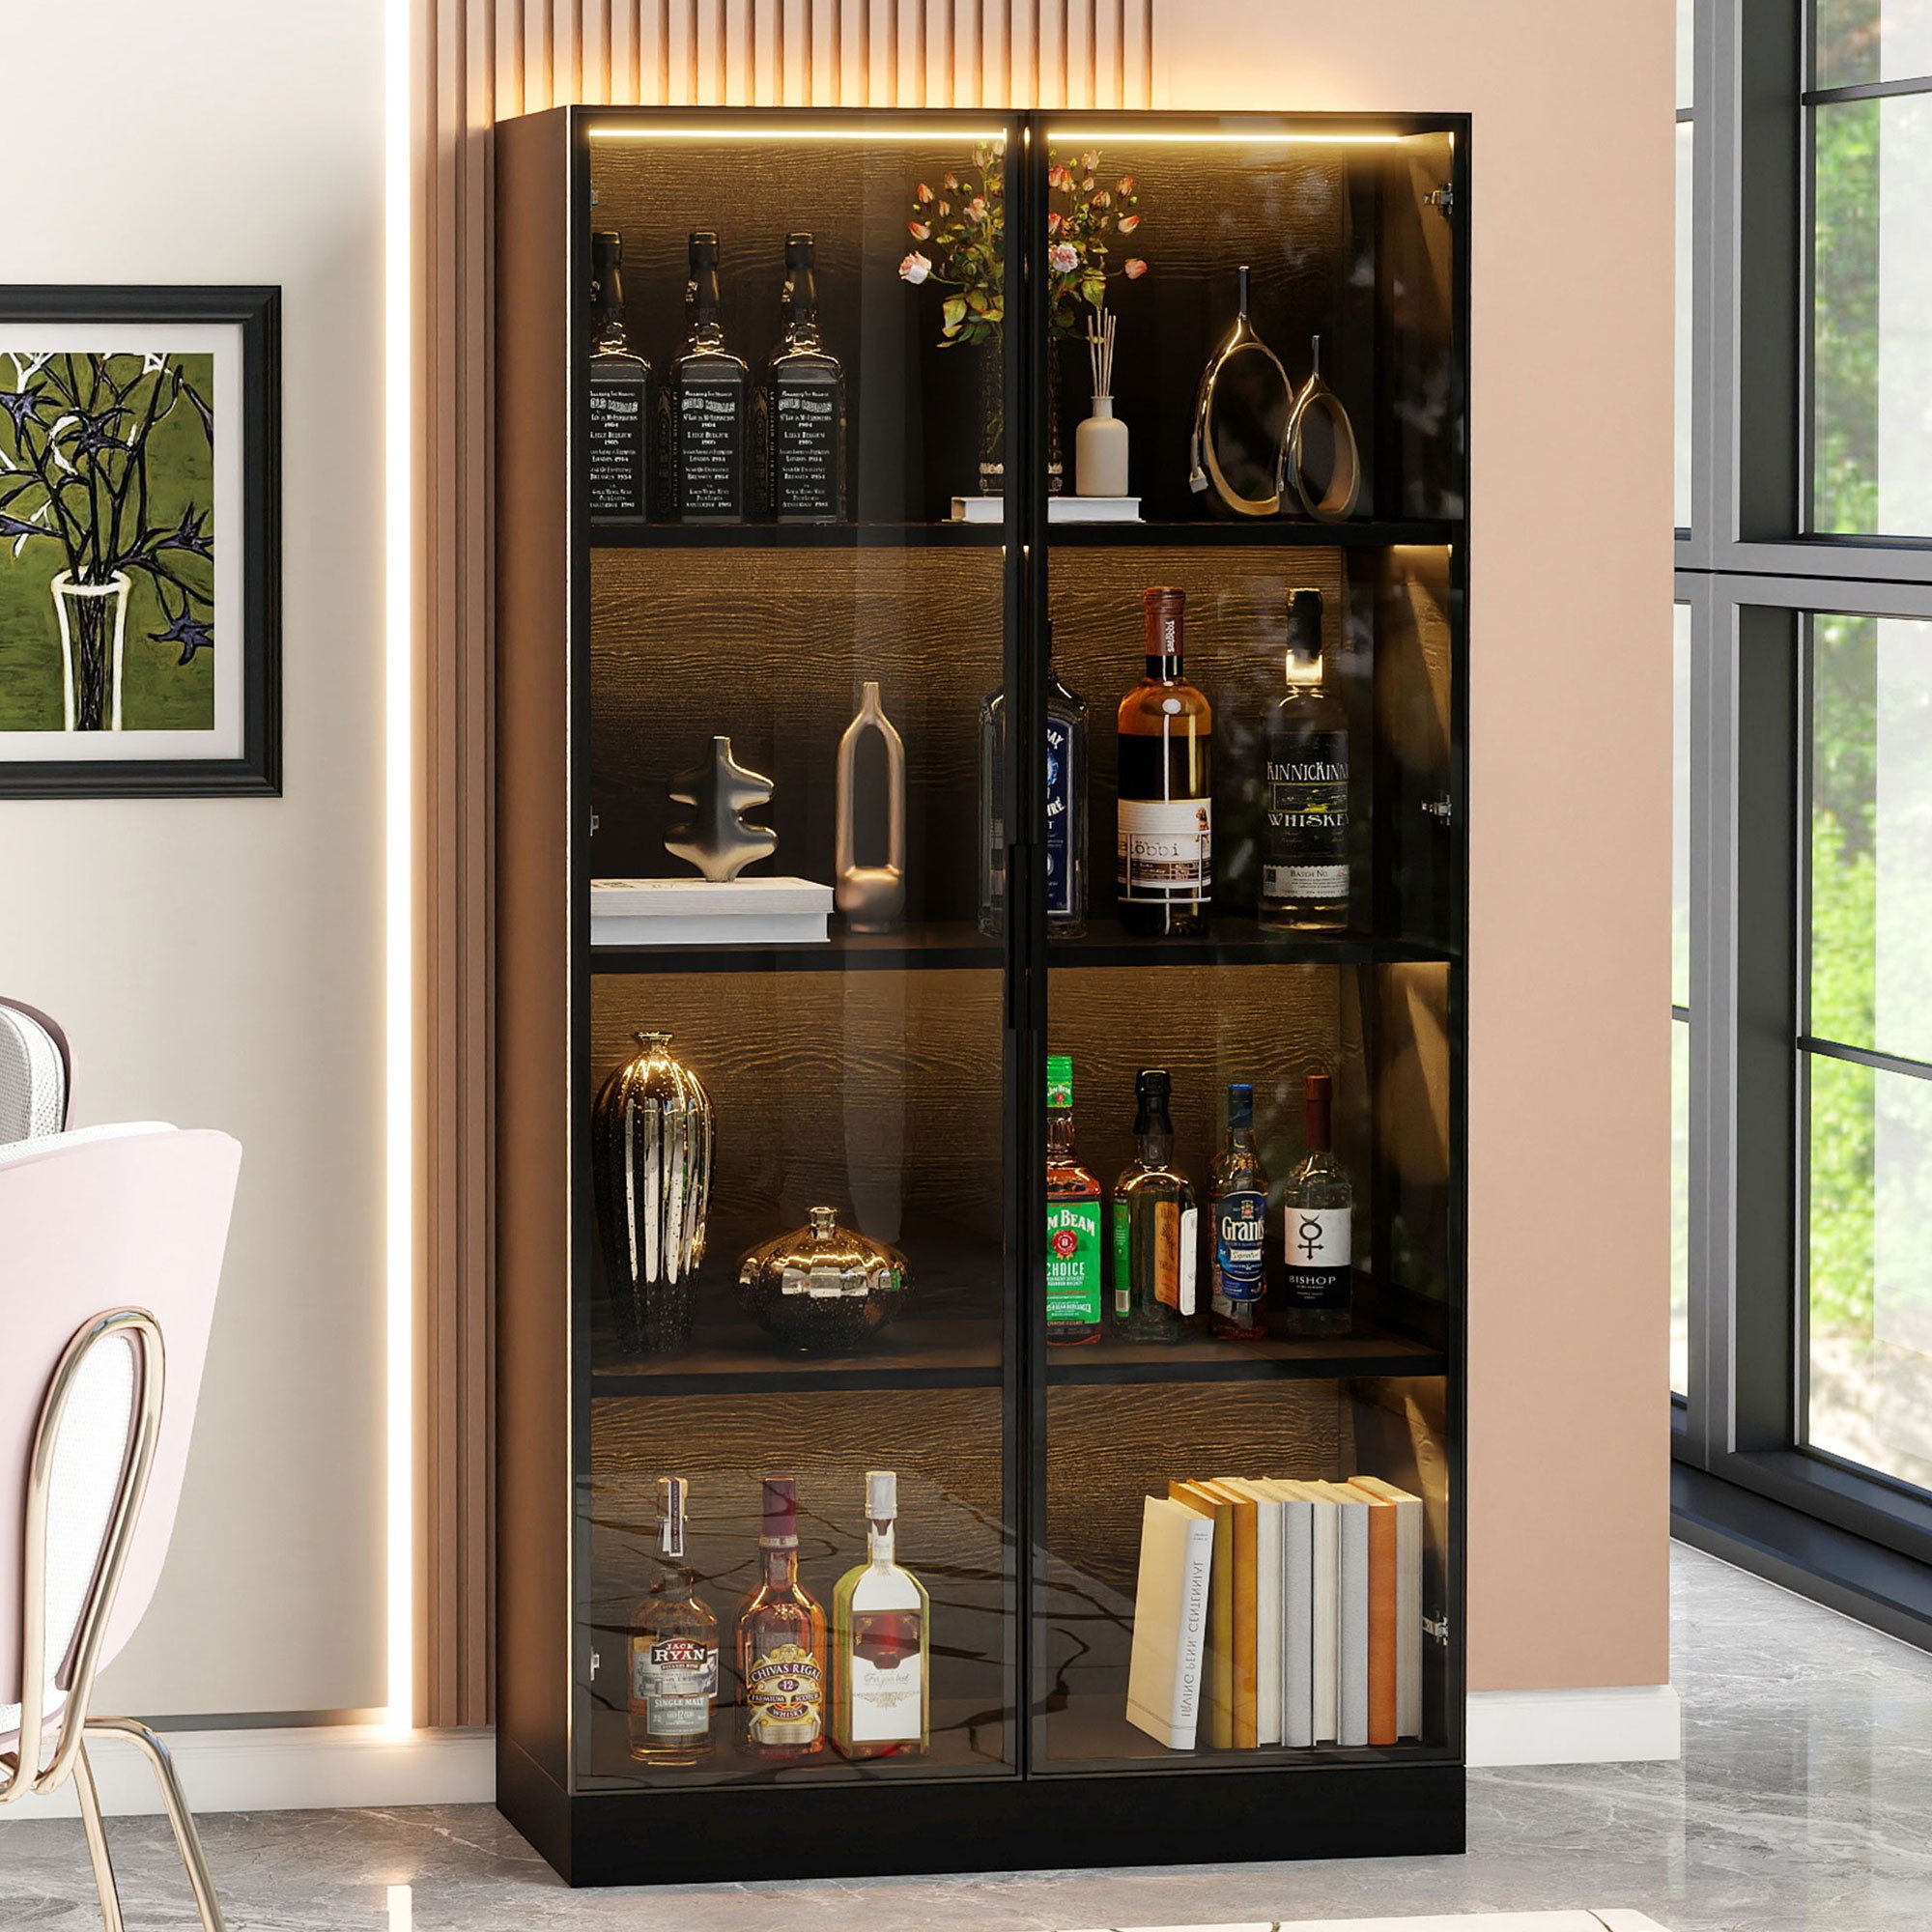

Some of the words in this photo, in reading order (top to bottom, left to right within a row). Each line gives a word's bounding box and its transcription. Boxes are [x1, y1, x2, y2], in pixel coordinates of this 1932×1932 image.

[1061, 1209, 1095, 1236] BEAM
[1289, 1275, 1336, 1285] BISHOP
[654, 1649, 705, 1662] RYAN
[752, 1663, 789, 1682] CHIVAS
[792, 1663, 821, 1680] REGAL
[783, 1680, 794, 1690] 12
[773, 1709, 804, 1718] WHISKY
